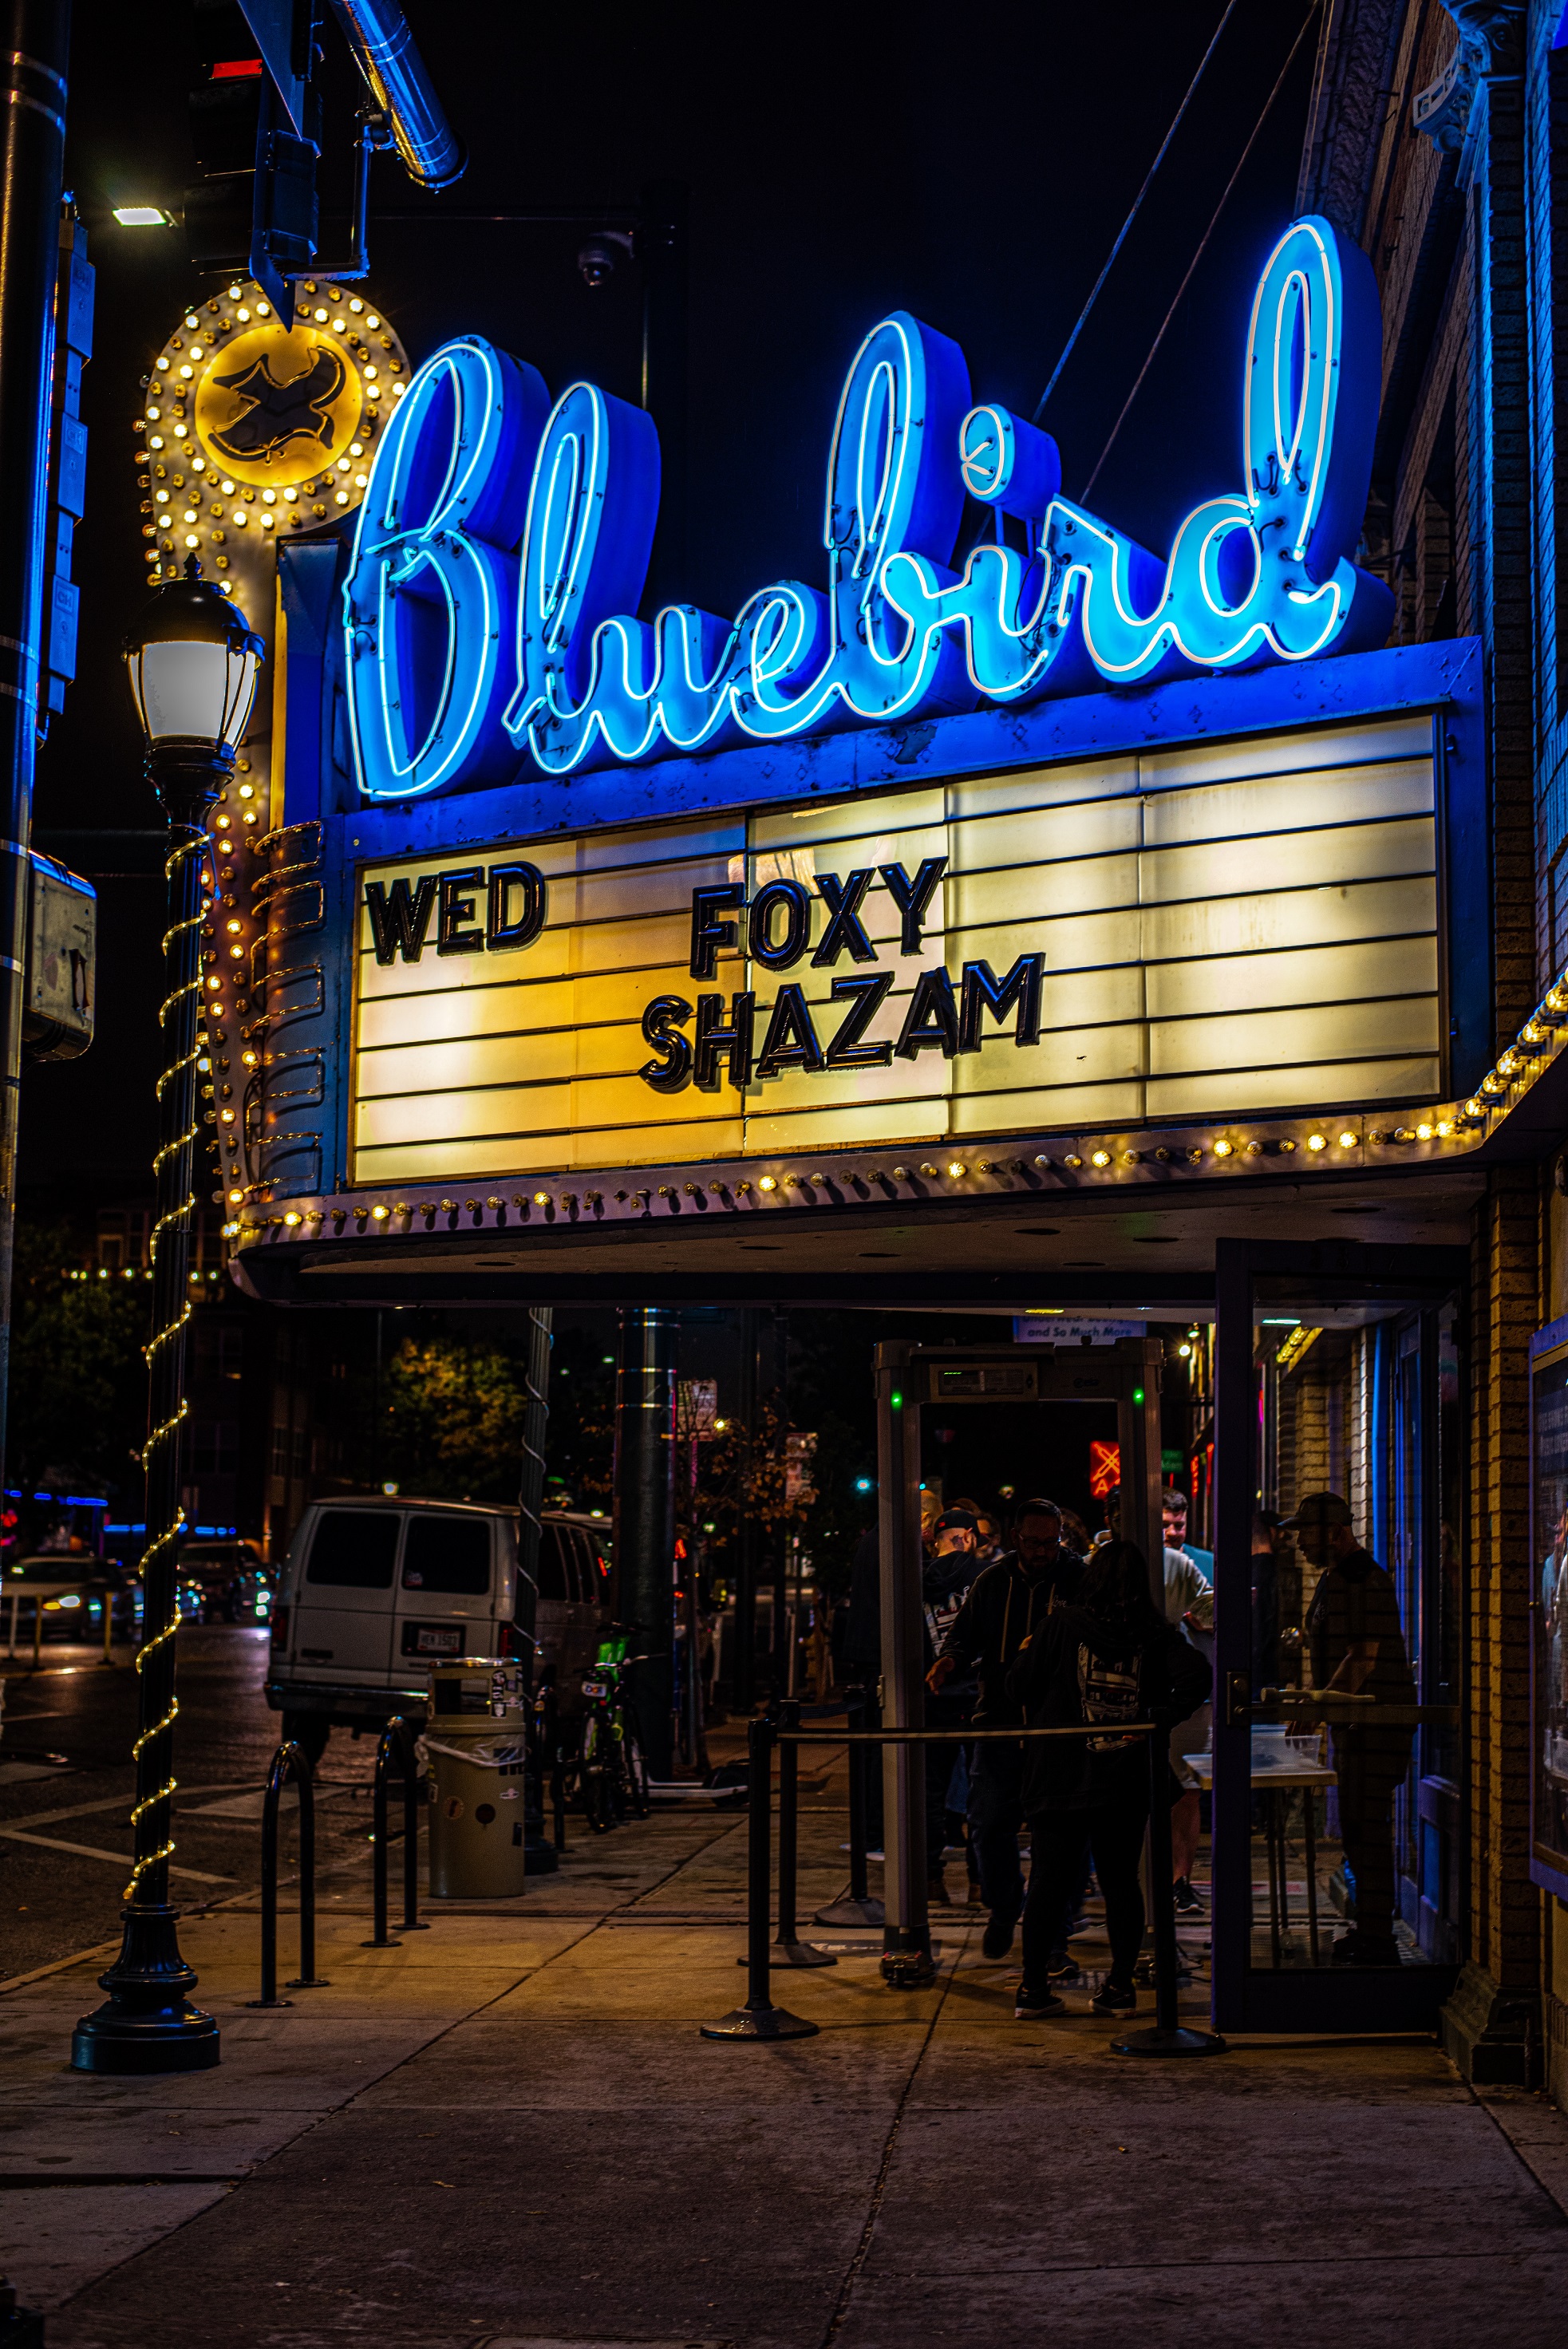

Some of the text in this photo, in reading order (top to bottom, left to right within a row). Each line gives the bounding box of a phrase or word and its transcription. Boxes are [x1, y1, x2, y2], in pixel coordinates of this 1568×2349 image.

[341, 214, 1358, 803] Bluebird
[365, 860, 546, 967] WED
[689, 856, 950, 979] FOXY
[638, 952, 1046, 1090] SHAZAM
[1028, 1327, 1132, 1337] and So Much More
